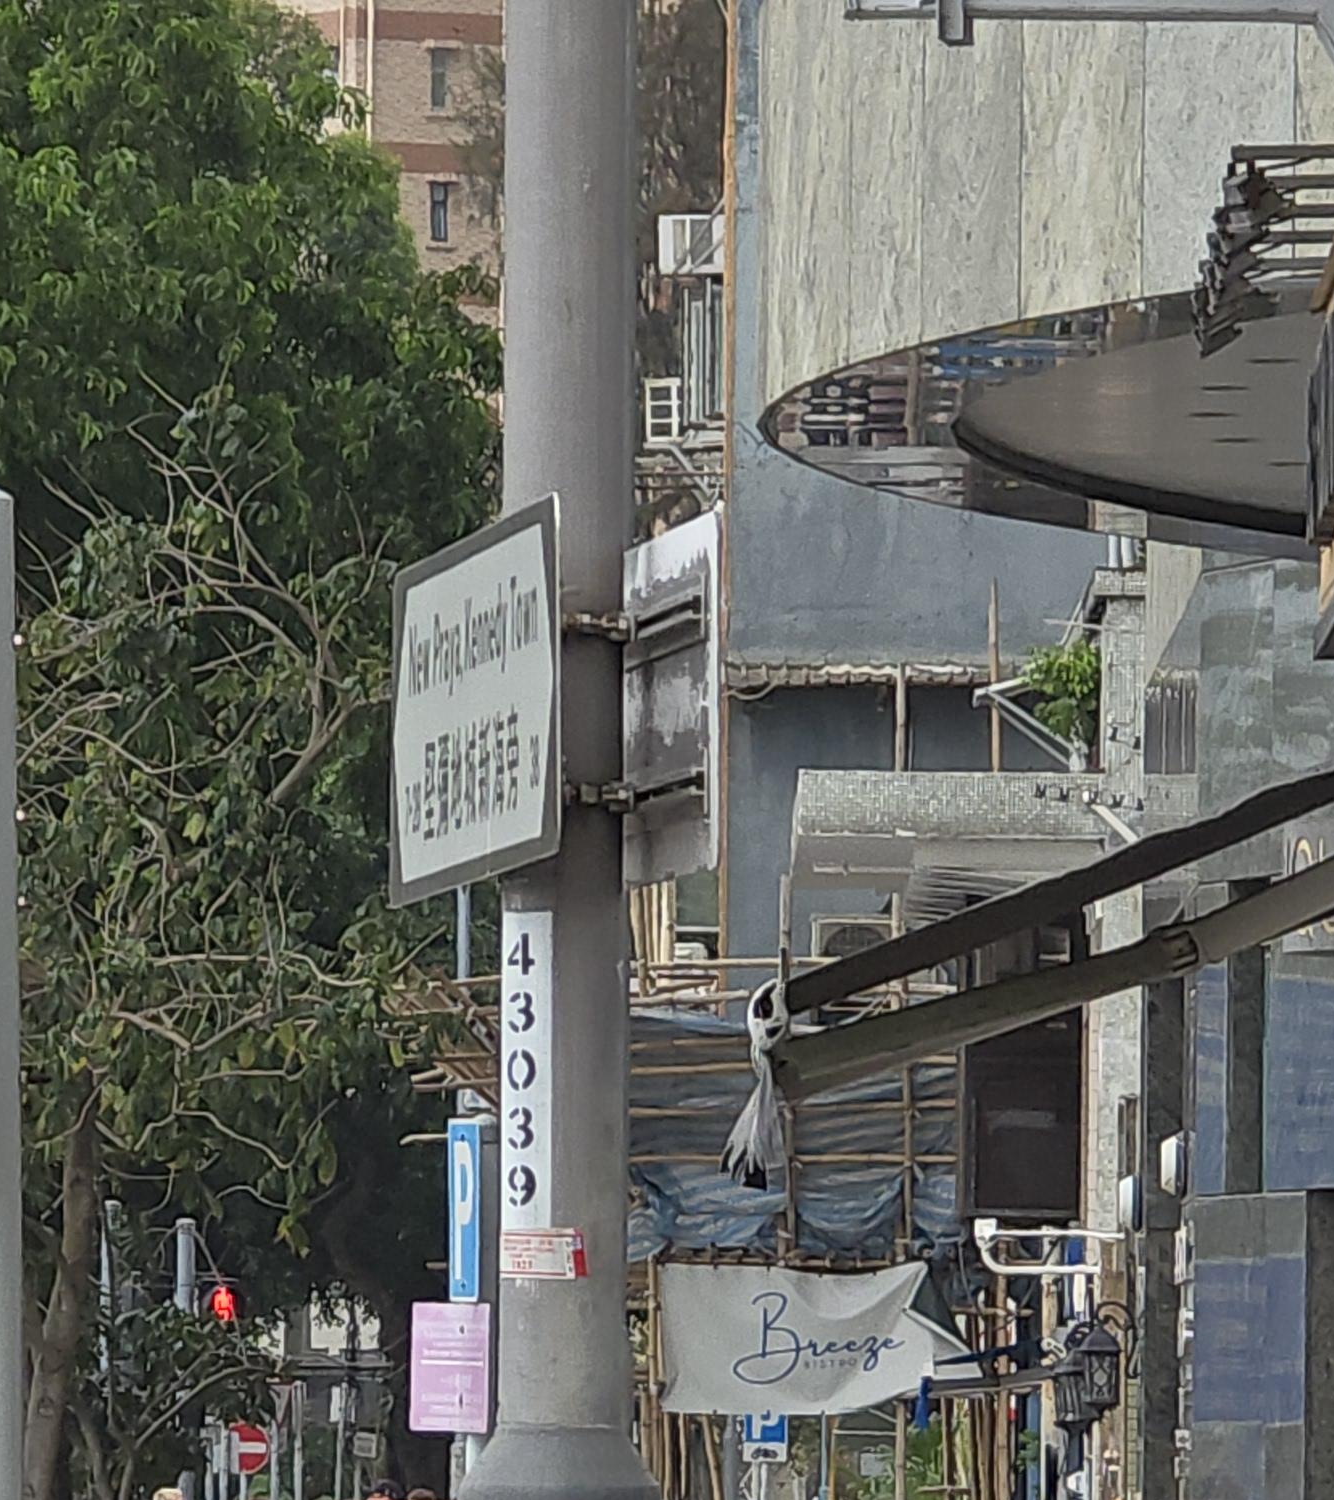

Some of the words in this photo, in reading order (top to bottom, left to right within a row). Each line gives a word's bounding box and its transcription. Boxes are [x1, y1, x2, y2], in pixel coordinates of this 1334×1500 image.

[407, 622, 431, 698] New
[464, 581, 509, 674] Kennedy
[510, 574, 539, 653] Town
[507, 932, 537, 1208] 43039
[453, 1140, 474, 1281] P
[733, 1291, 906, 1385] Breeze
[803, 1358, 858, 1370] BISTRO
